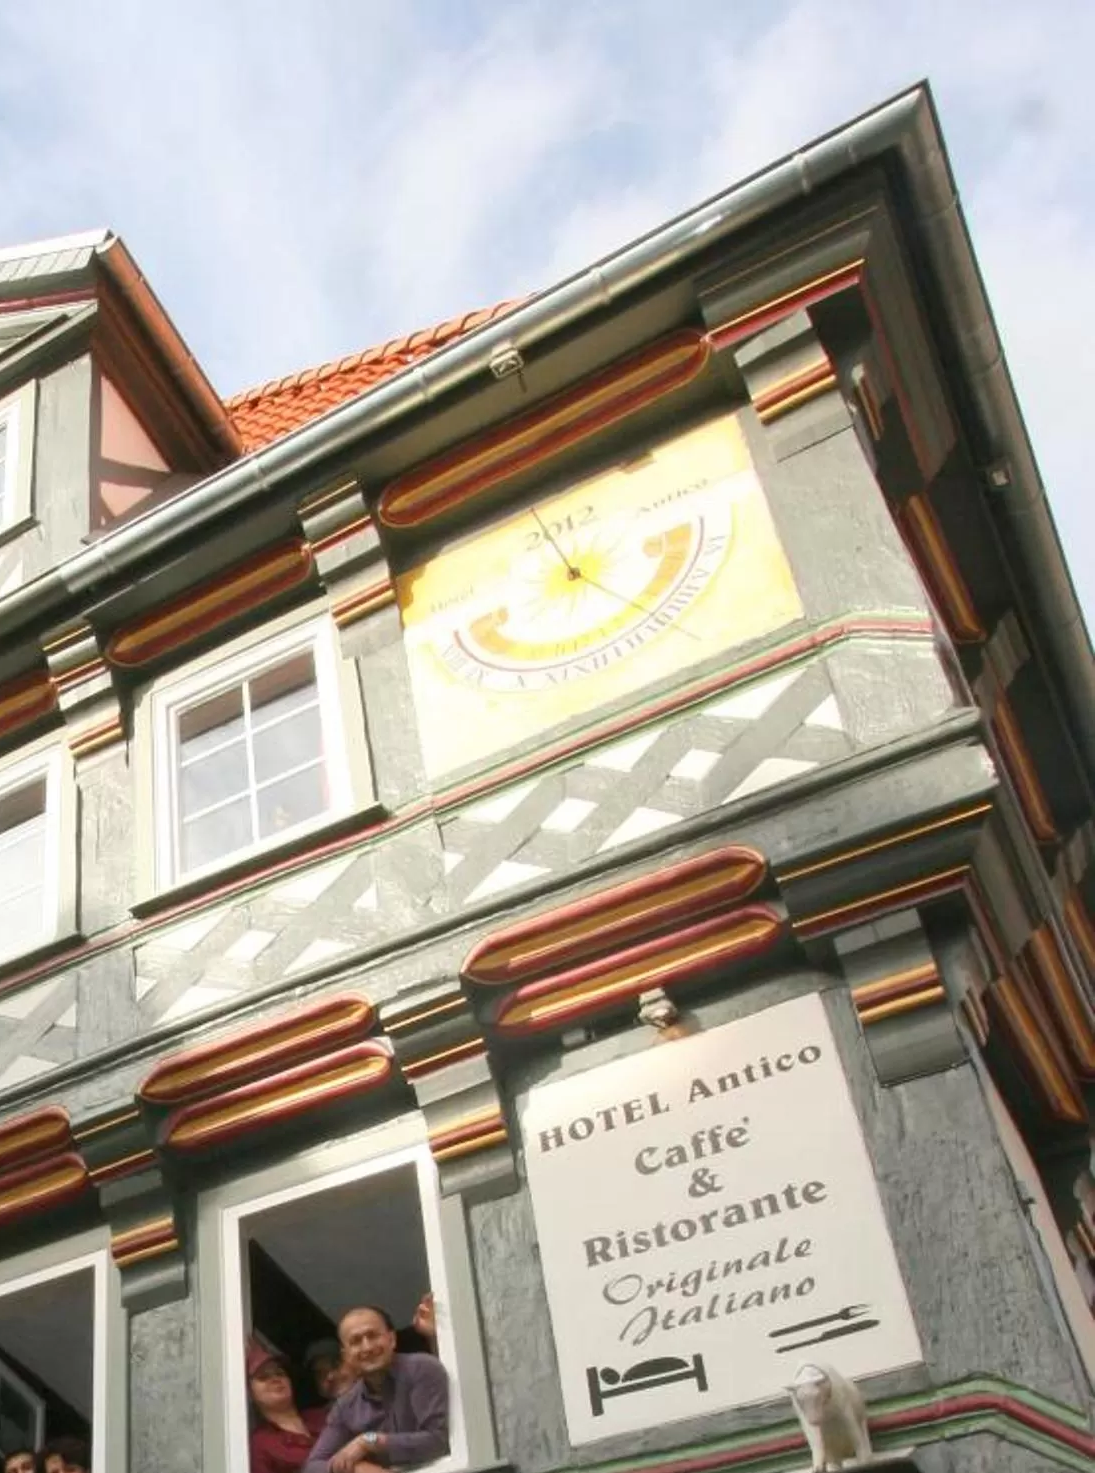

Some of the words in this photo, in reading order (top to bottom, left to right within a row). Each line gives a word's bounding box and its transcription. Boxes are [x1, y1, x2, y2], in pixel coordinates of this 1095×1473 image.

[525, 505, 600, 551] 2012
[537, 1092, 670, 1153] HOTEL
[688, 1044, 822, 1104] Antico
[687, 1166, 725, 1198] &
[582, 1180, 828, 1268] Ristorante
[602, 1236, 814, 1306] Originale
[618, 1275, 816, 1346] Italiano
